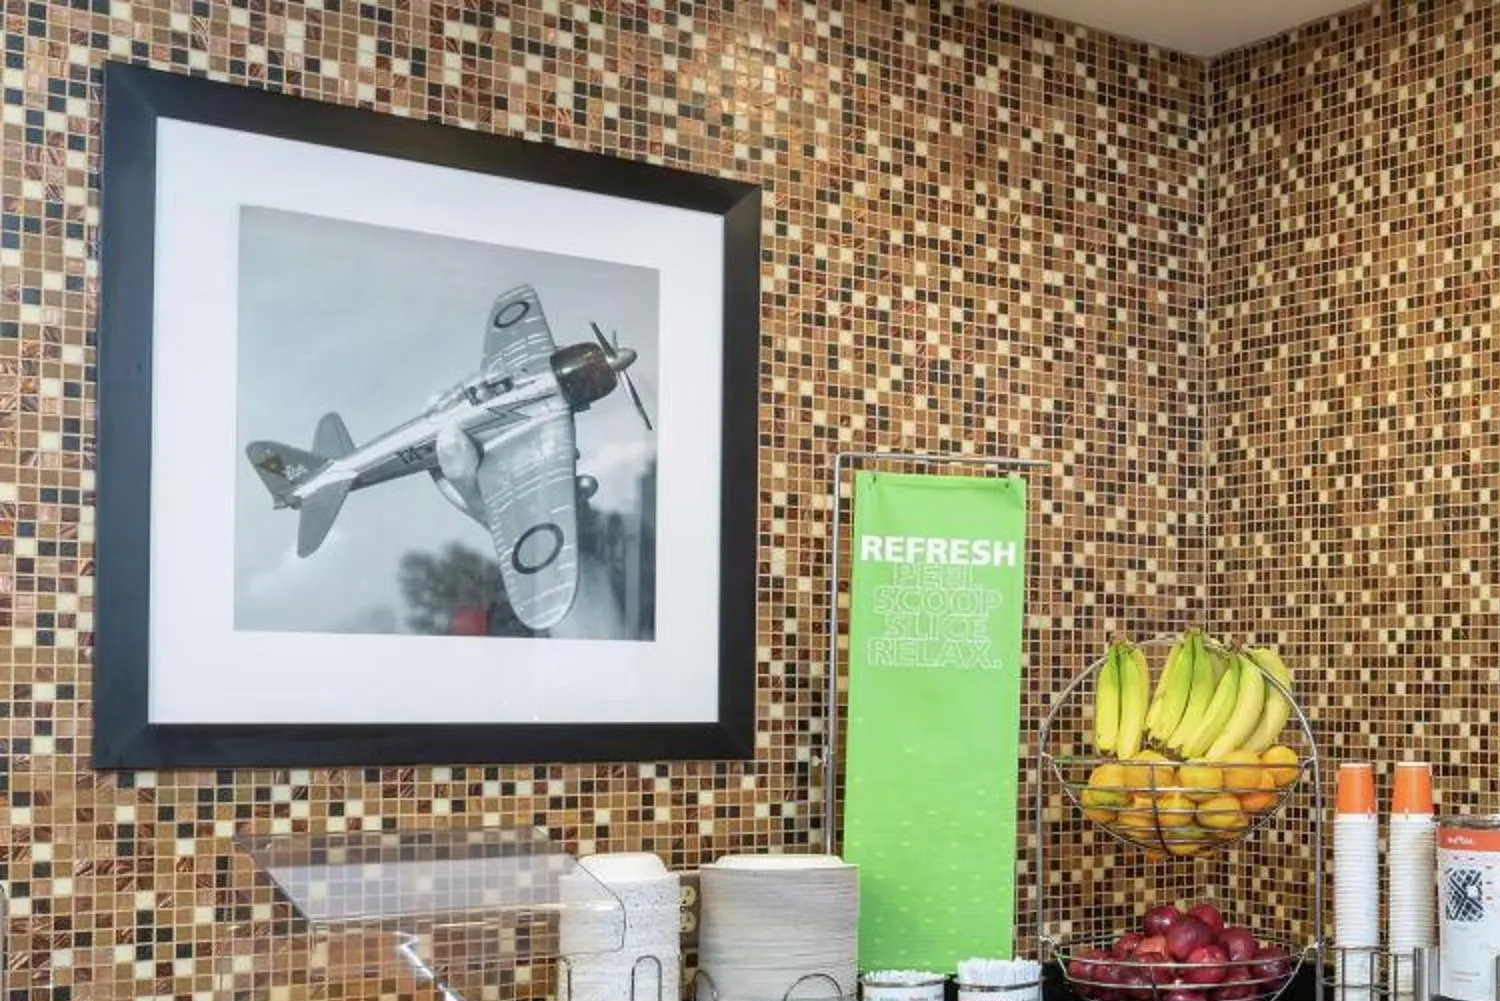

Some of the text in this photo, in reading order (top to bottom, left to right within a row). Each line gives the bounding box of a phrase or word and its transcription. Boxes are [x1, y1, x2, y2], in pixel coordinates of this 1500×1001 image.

[860, 535, 1016, 567] REFRESH
[873, 586, 1002, 615] SCOOP
[884, 613, 990, 642] SLICE
[867, 637, 1003, 669] RELAX.
